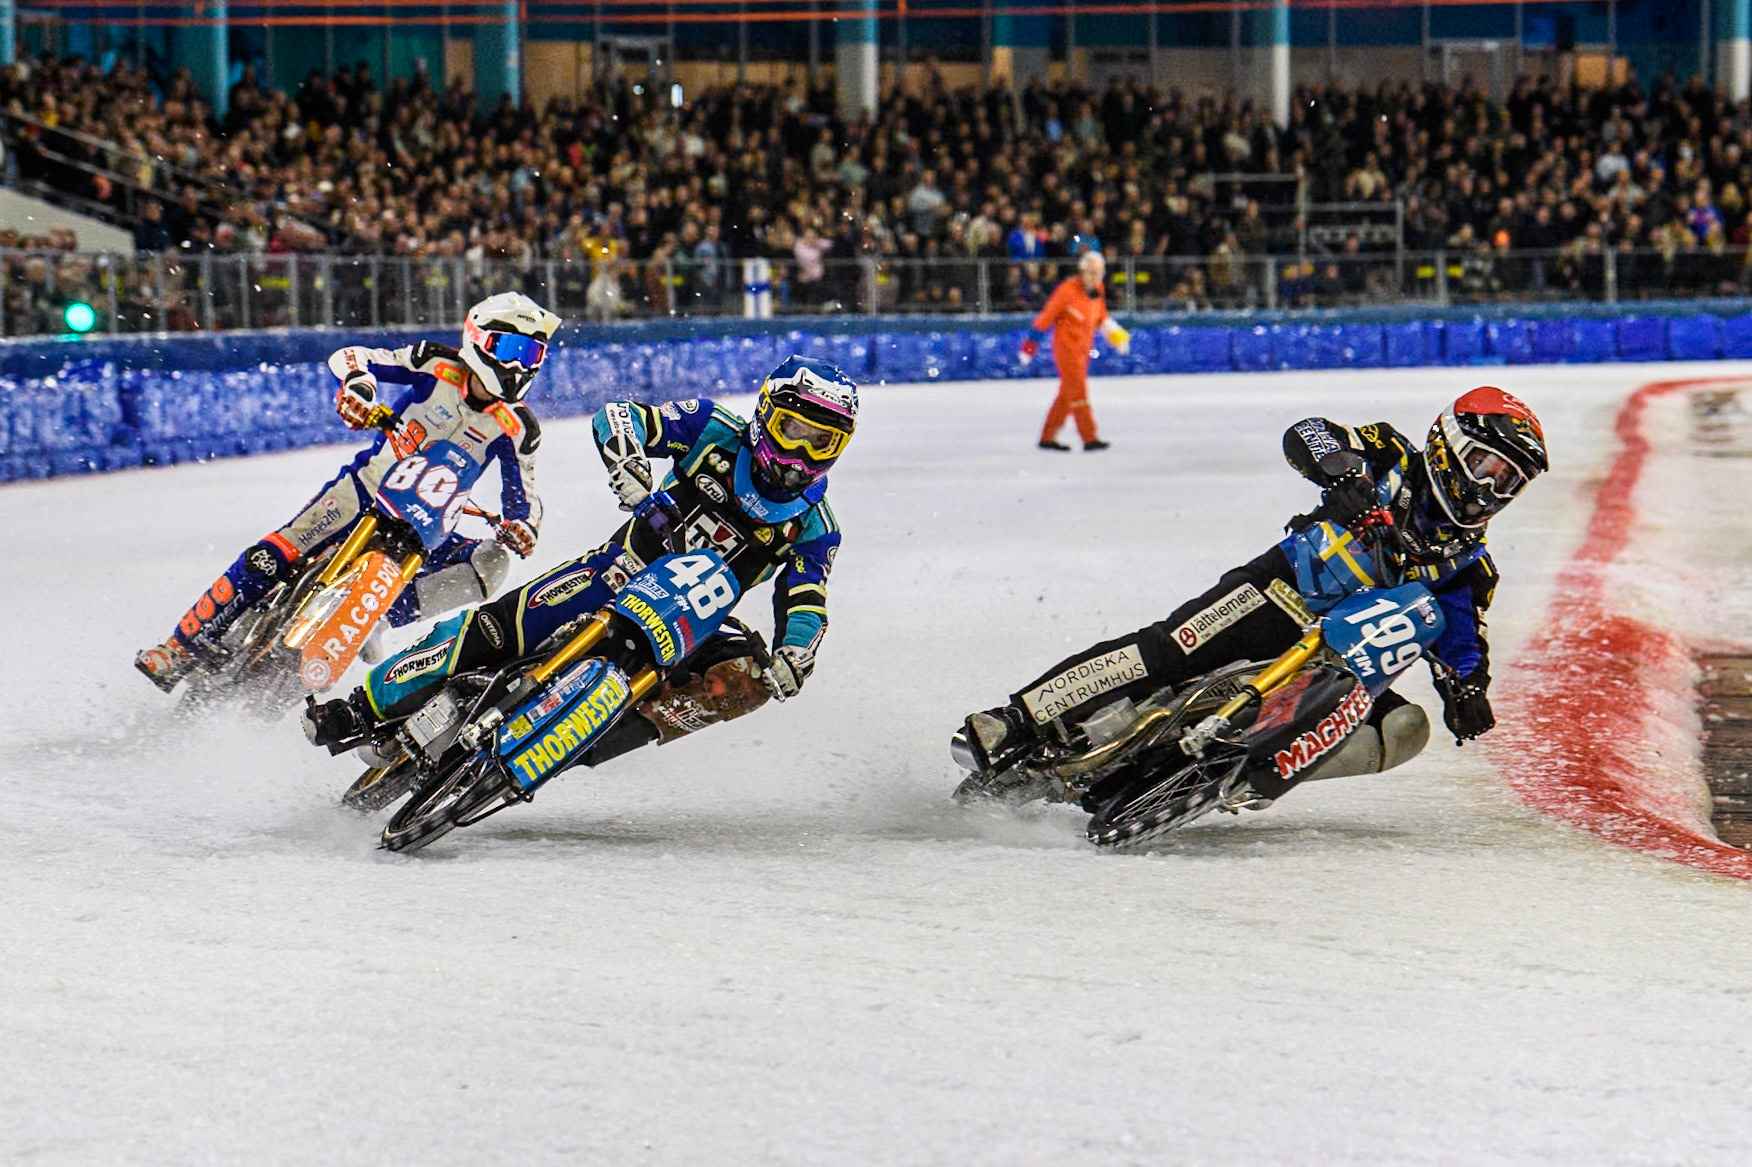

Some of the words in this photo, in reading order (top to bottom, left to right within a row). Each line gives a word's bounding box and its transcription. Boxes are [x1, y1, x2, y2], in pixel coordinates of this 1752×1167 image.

[298, 507, 342, 546] Horses2fly
[664, 554, 735, 620] 48
[1191, 586, 1259, 634] lättelement
[480, 614, 502, 647] ORTEMA
[620, 594, 676, 663] THORWESTEN
[1344, 598, 1422, 676] 199
[1034, 662, 1146, 723] CENTRUMHUS
[1037, 650, 1130, 703] NORDISKA
[513, 676, 627, 781] THORWESTEN
